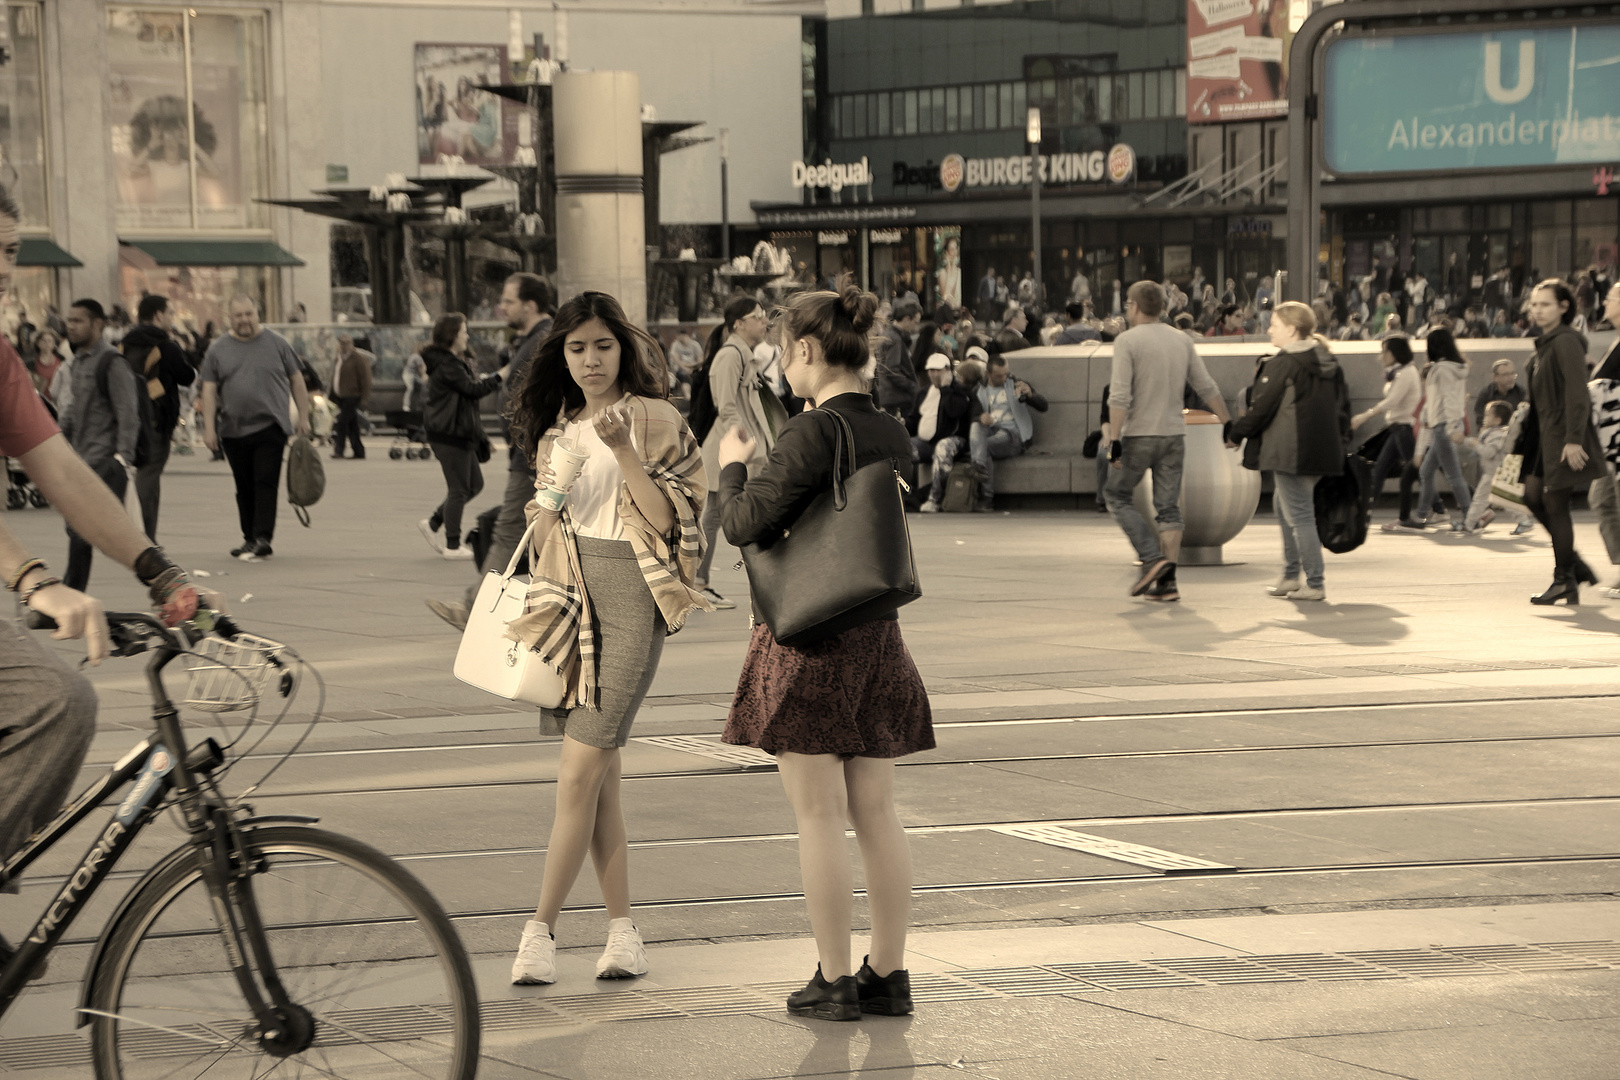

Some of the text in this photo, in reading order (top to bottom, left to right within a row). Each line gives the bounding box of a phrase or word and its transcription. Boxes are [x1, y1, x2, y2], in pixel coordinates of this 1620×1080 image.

[1484, 39, 1536, 105] U
[966, 156, 1048, 187] BURGER
[1051, 151, 1105, 182] KING
[28, 821, 126, 944] VICTORIA
